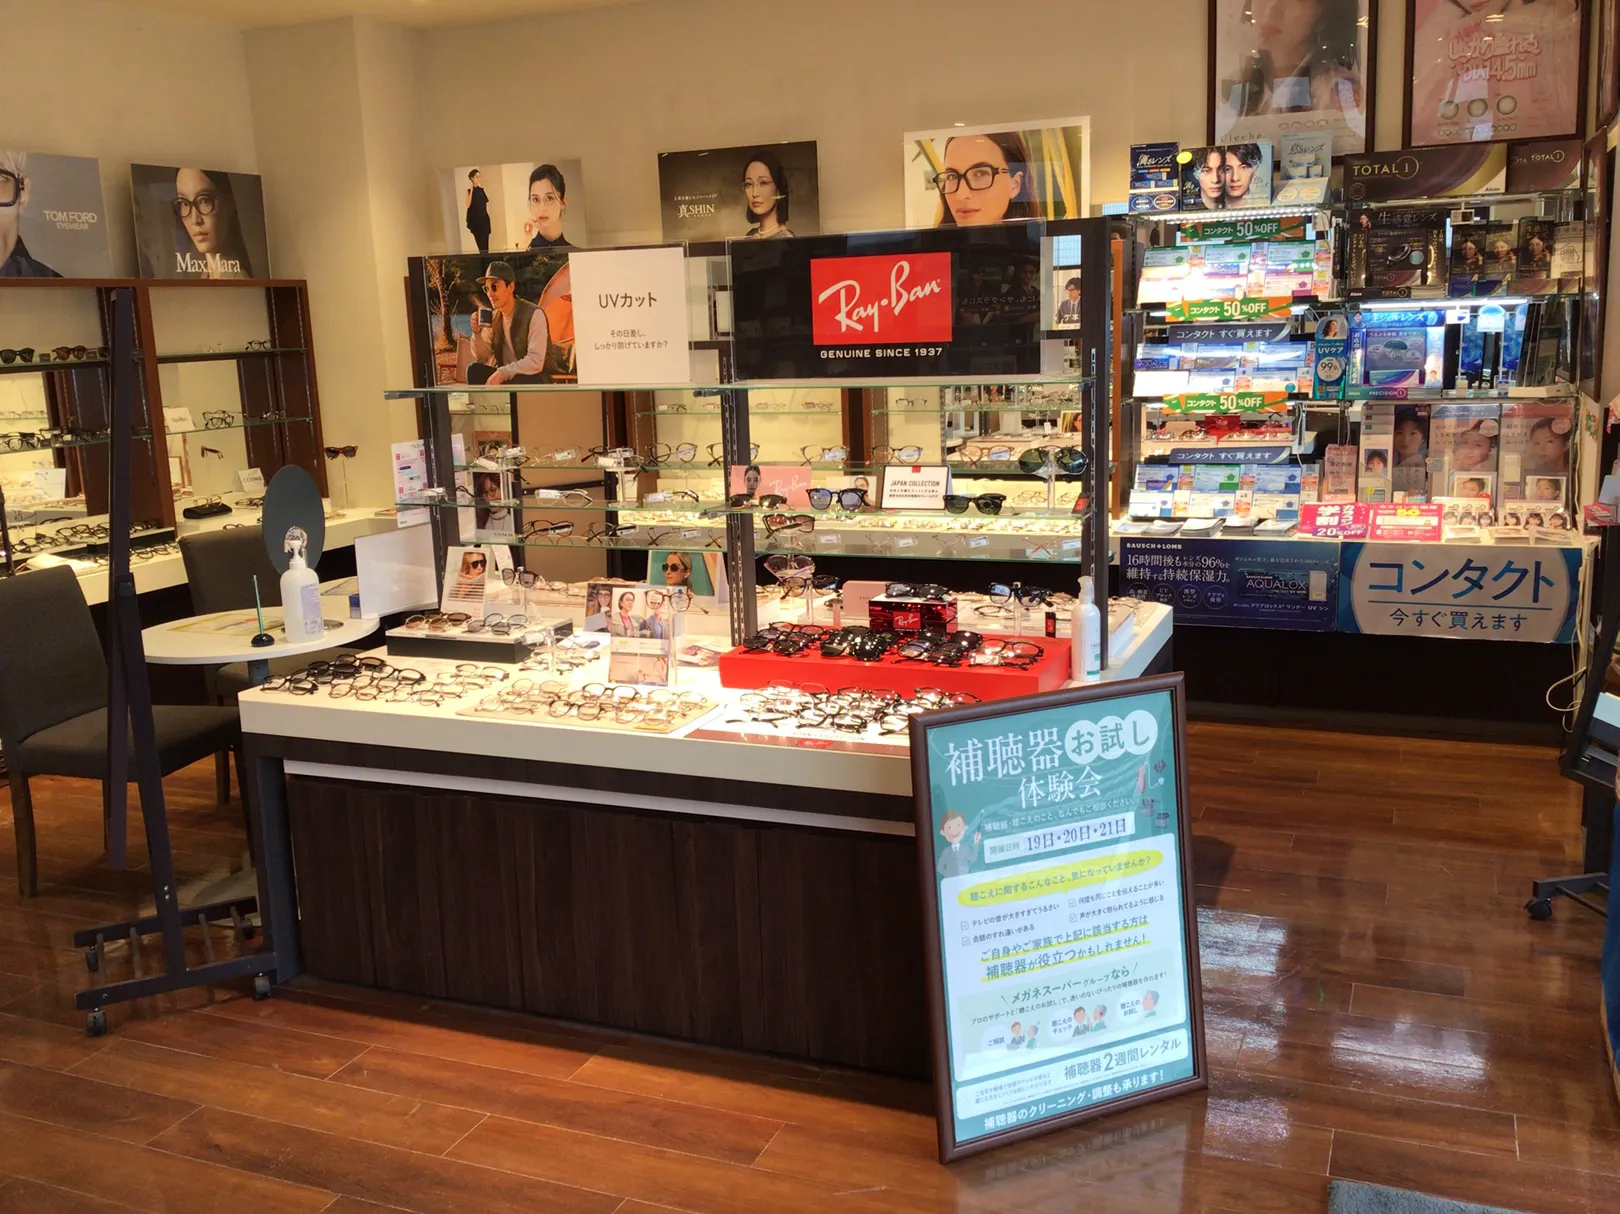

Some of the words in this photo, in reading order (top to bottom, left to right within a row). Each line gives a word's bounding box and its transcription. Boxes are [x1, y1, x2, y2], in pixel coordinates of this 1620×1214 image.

[44, 210, 69, 223] TOM
[69, 210, 98, 223] FORD
[56, 221, 89, 230] EYEWEAR
[1203, 226, 1234, 235] コンタクト
[175, 252, 241, 273] MaxMara
[598, 291, 657, 309] UVカット
[1190, 306, 1220, 314] コンタクト
[1176, 329, 1215, 339] コンタクト
[1219, 329, 1273, 339] すぐ買えます
[820, 349, 871, 358] GENUINE
[875, 348, 911, 358] SINCE
[915, 347, 943, 357] 1937
[1176, 452, 1215, 460] コンタクト
[1219, 451, 1273, 460] すぐ買えます
[1246, 579, 1307, 590] AQUALOX
[1368, 558, 1555, 604] コンタクト
[1389, 608, 1528, 632] 今すぐ買えます
[944, 727, 1063, 786] 補聴器
[1071, 720, 1150, 757] お試し
[1017, 765, 1104, 810] 体験会
[988, 841, 1021, 856] 開催日時
[971, 903, 1060, 928] テレビの音が大きすぎてうるさい
[980, 915, 1148, 962] ご自身やご家族で上記に該当する方は
[986, 933, 1147, 981] 補聴器が役立つかもしれません!
[1011, 965, 1131, 1004] メガネスーパーグループなら
[1063, 1038, 1181, 1081] 補聴器2週間レンタル
[983, 1069, 1165, 1131] 補聴器のクリーニング・調整も承ります!
